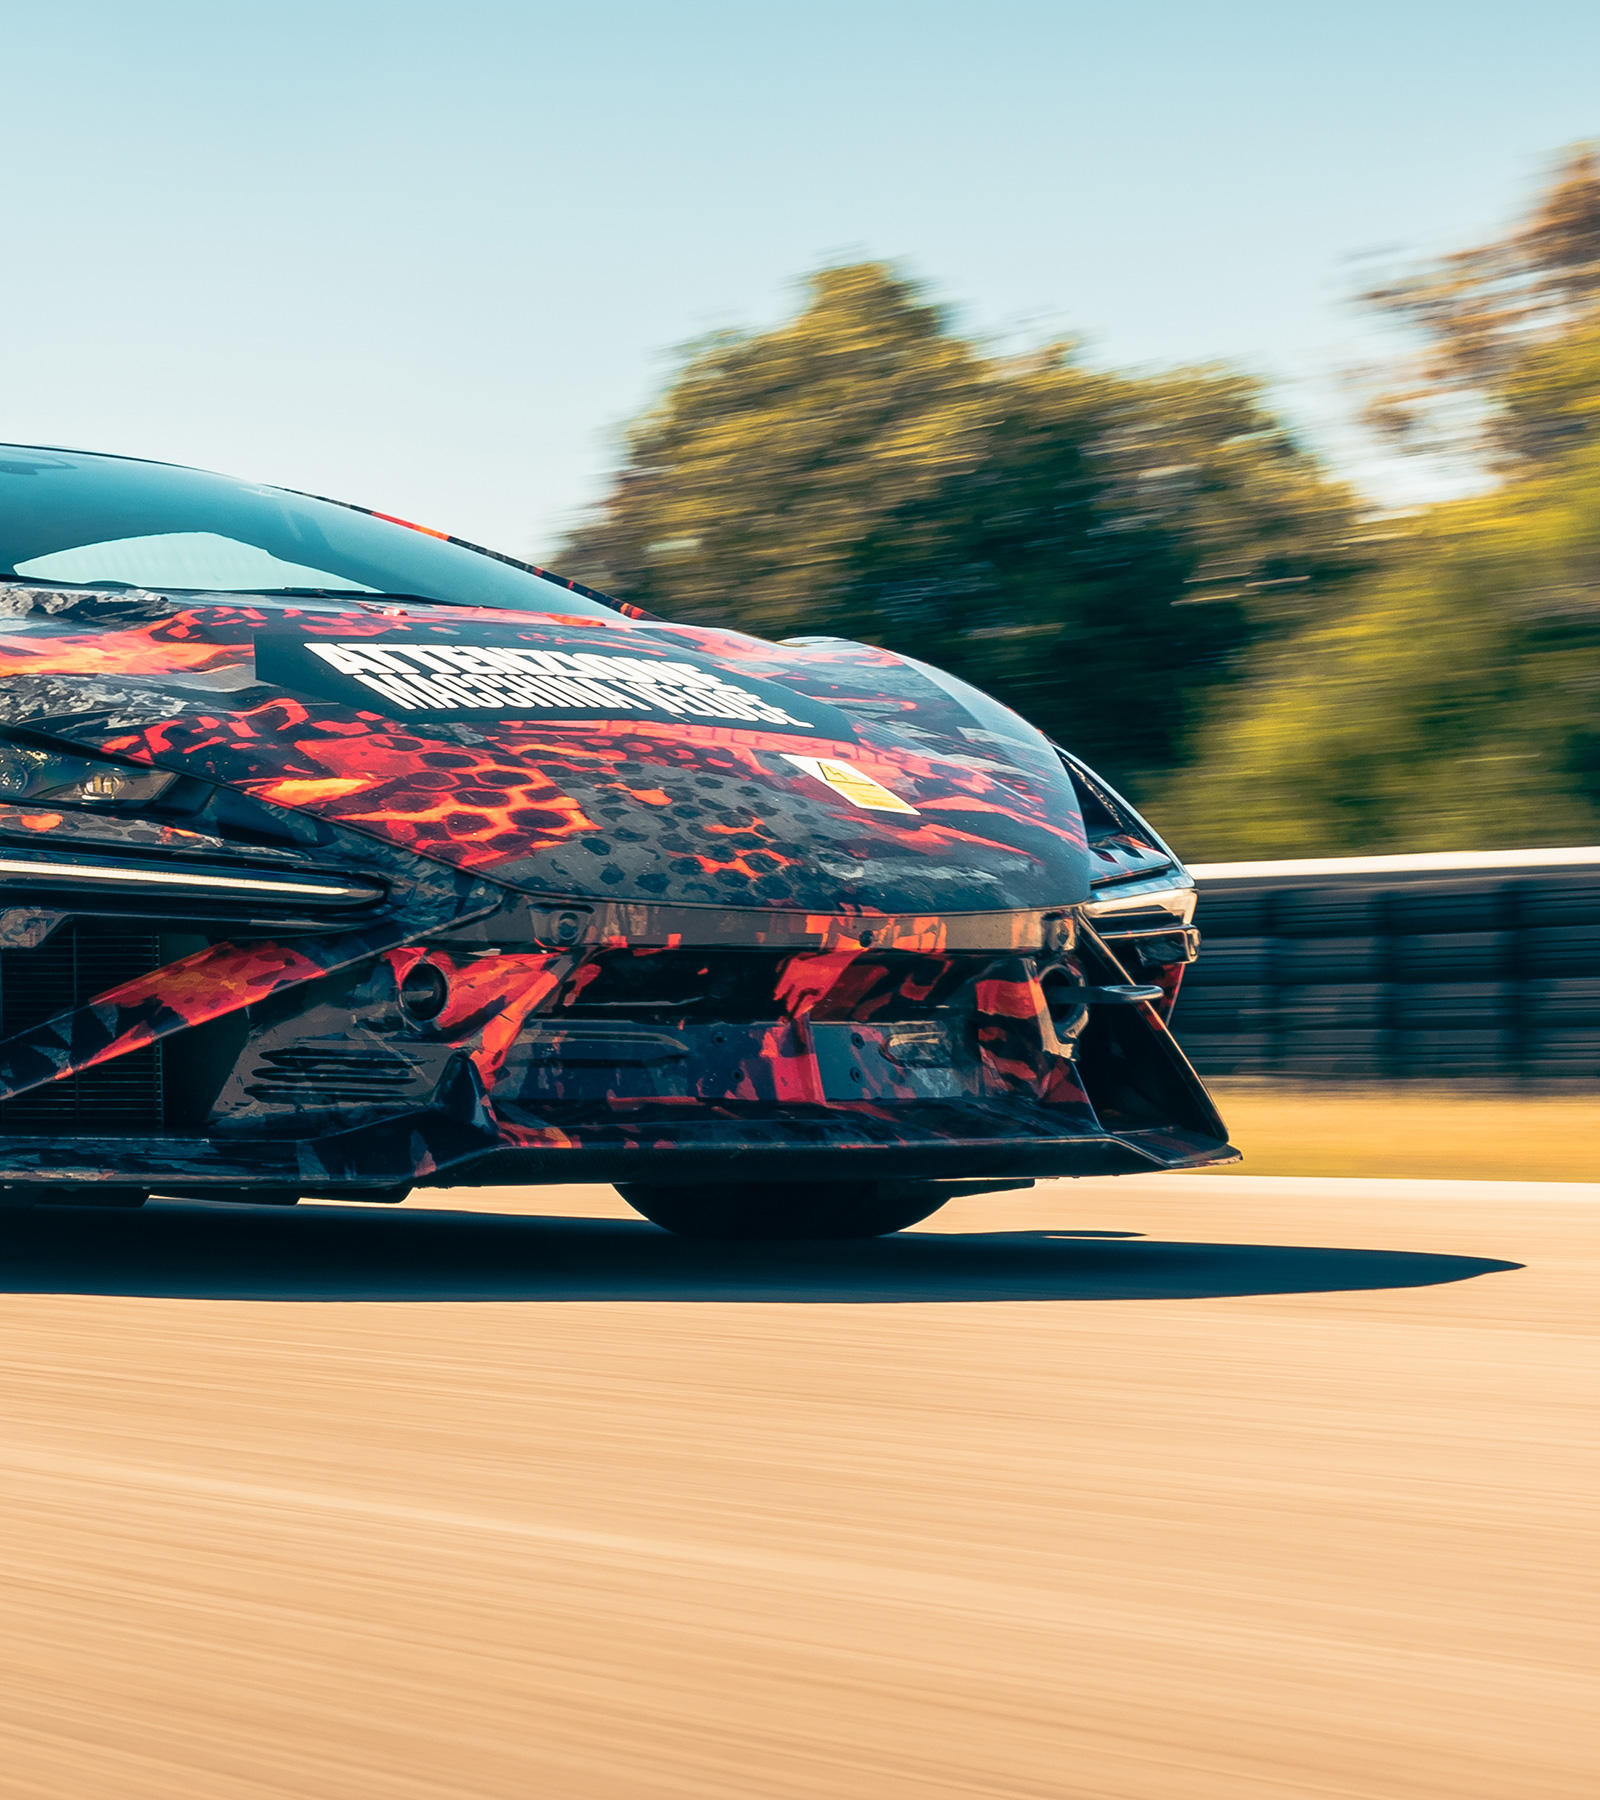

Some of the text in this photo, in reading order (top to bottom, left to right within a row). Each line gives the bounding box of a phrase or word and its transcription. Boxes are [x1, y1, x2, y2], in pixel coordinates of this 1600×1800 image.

[303, 642, 748, 694] ATTENZIONE
[352, 674, 815, 728] MACCHINA VELOCE
